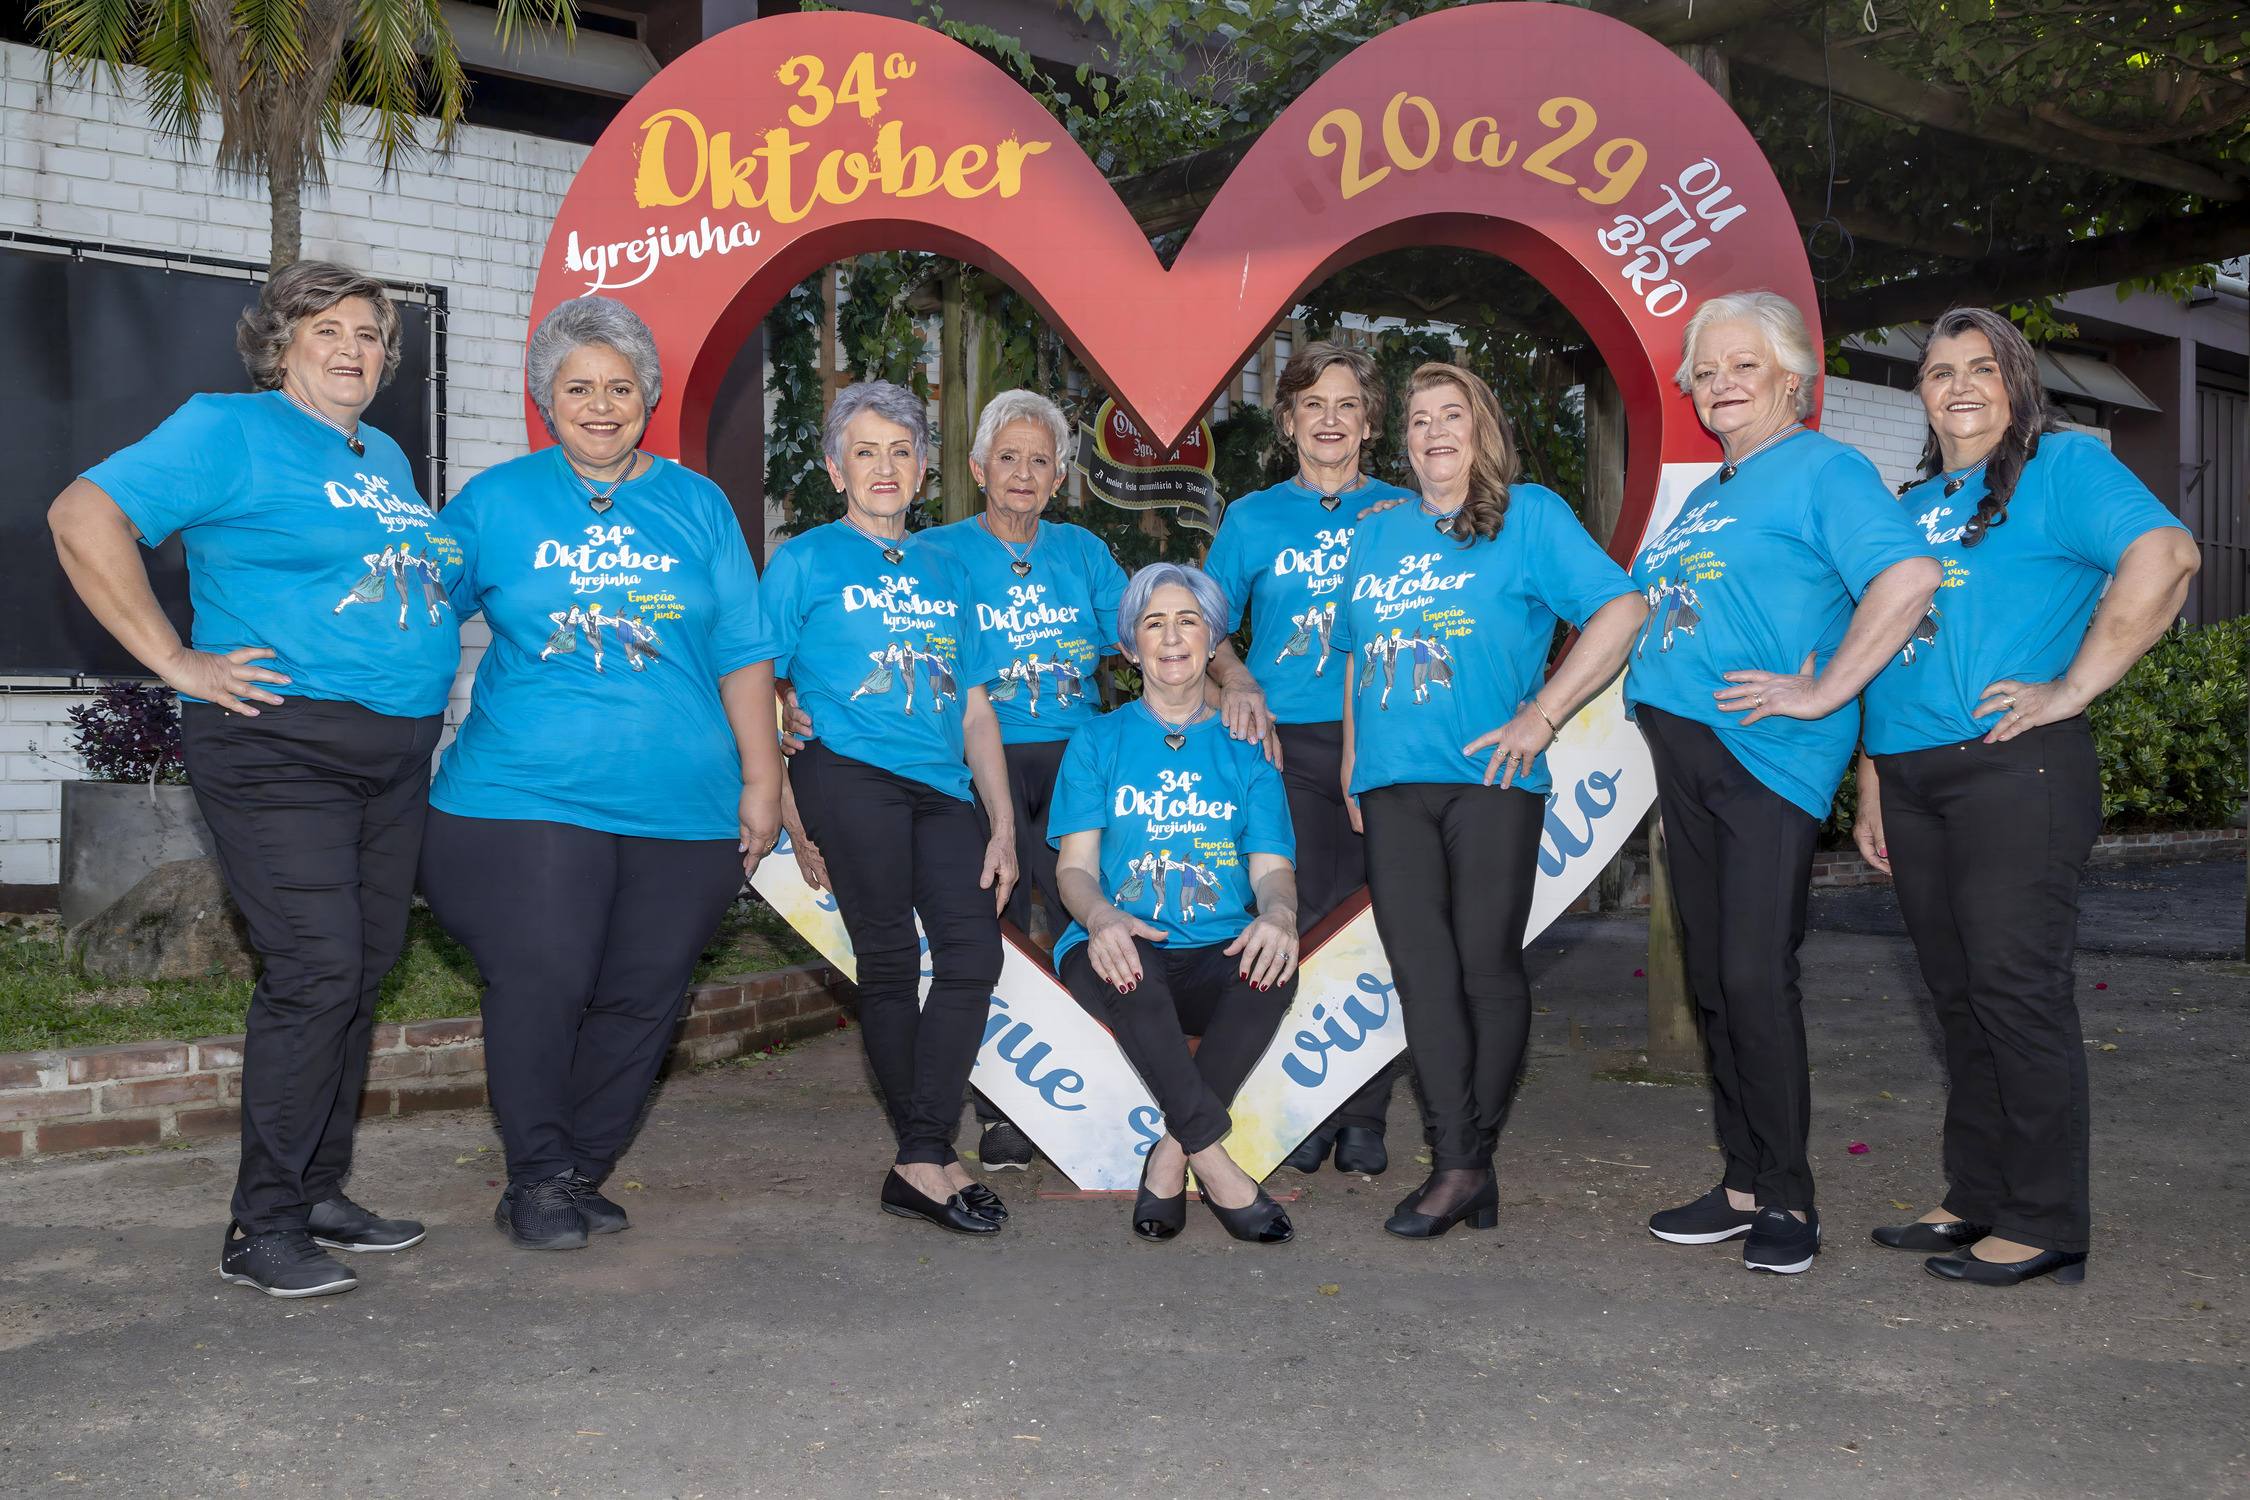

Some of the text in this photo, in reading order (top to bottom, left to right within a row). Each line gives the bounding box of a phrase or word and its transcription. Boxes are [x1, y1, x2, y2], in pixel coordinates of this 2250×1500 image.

[1308, 92, 1648, 206] 20 a 29
[633, 108, 1052, 224] Oktober
[1678, 157, 1747, 233] OU
[1642, 184, 1711, 266] TU
[563, 217, 760, 298] Igrejinha
[1597, 214, 1688, 318] BRO
[1106, 477, 1123, 489] maior
[1125, 481, 1137, 491] festa
[1175, 480, 1183, 490] do
[1186, 481, 1208, 496] Brasil
[323, 481, 437, 520] Oktober
[377, 512, 429, 533] Igrejinha
[534, 539, 679, 573] Oktober
[1274, 546, 1351, 576] Okto
[1644, 539, 1692, 573] Igrejinha
[1680, 547, 1715, 566] Emoção
[569, 570, 641, 594] Igrejinha
[1307, 573, 1344, 597] Igreji
[1351, 570, 1476, 602] Oktober
[1695, 569, 1723, 584] junto
[627, 589, 676, 603] Emoção
[640, 603, 656, 613] que
[667, 602, 686, 611] vive
[842, 584, 958, 618] Oktober
[1374, 595, 1435, 622] Igrejinha
[653, 610, 682, 622] junto
[976, 602, 1080, 632] Oktober
[1422, 605, 1465, 622] Emoção
[1433, 621, 1446, 631] que
[1008, 627, 1062, 649] Igrejinha
[1445, 626, 1473, 640] junto
[1114, 785, 1237, 821] Oktober
[1146, 818, 1206, 841] Igrejinha
[1193, 837, 1235, 850] Emoção
[1204, 851, 1218, 859] que
[1281, 972, 1394, 1088] viv
